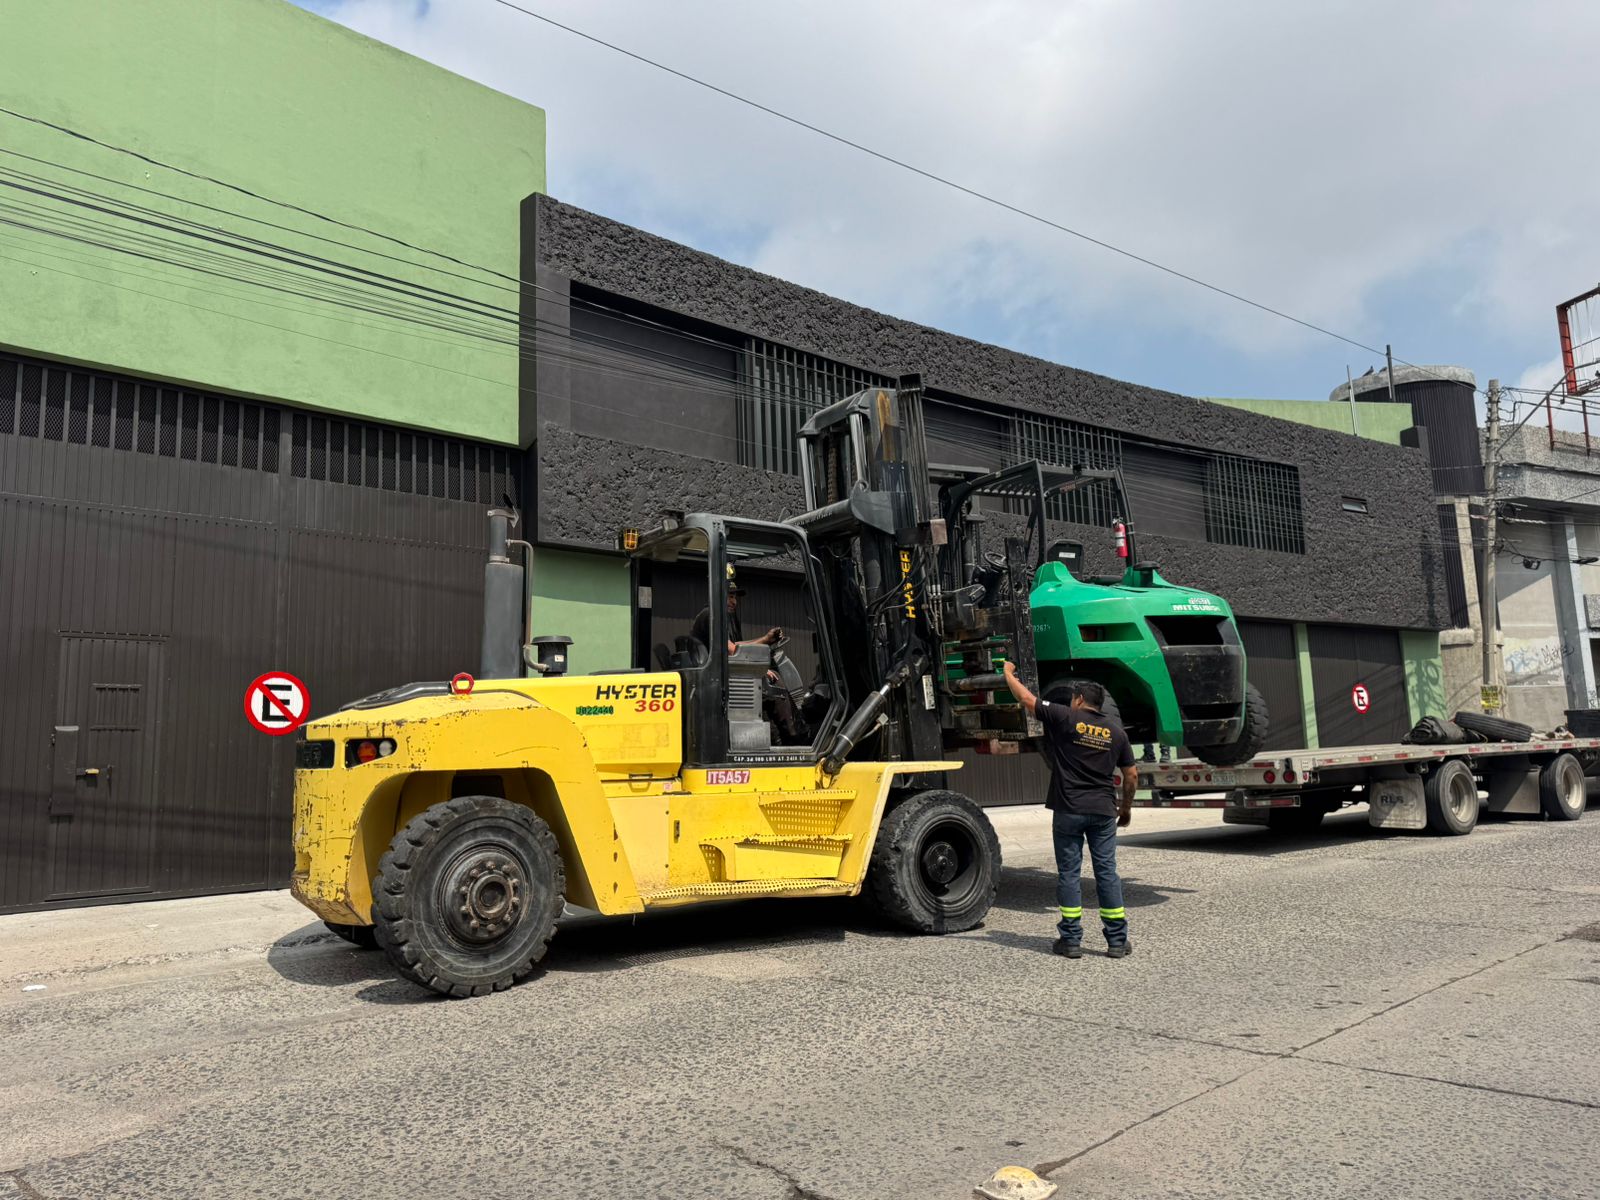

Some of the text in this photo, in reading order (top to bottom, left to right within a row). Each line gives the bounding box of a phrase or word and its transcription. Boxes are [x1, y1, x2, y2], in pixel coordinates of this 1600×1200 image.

[595, 684, 677, 700] HYSTER
[634, 699, 675, 713] 360
[1087, 724, 1111, 738] TFC
